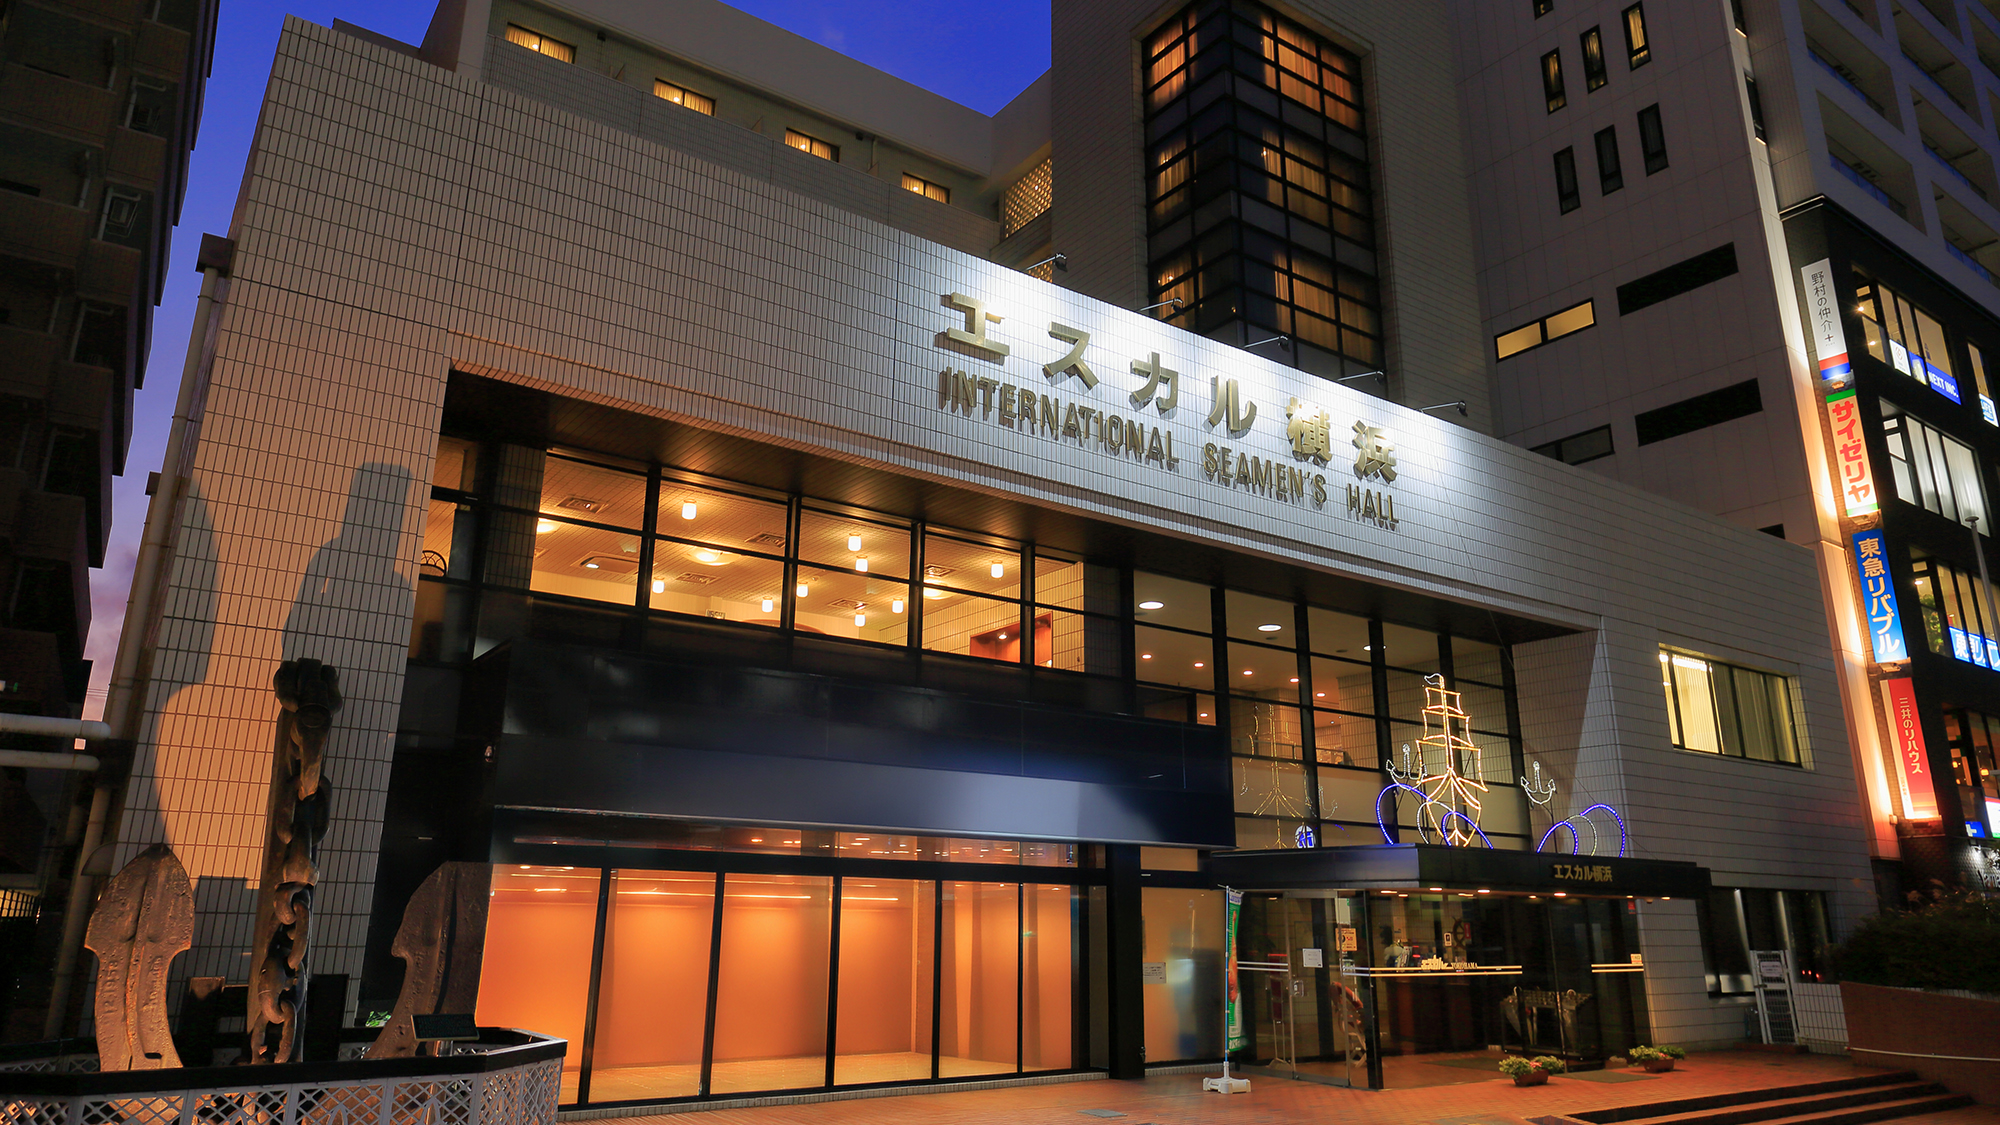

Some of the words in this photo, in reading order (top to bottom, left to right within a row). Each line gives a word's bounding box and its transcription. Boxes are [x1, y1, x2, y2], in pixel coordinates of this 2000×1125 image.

[940, 366, 1179, 469] INTERNATIONAL
[1203, 441, 1328, 507] SEAMEN'S
[1347, 483, 1400, 528] HALL
[1831, 399, 1871, 504] サイゼリヤ
[1857, 537, 1901, 656] 東急リバブル
[1899, 697, 1923, 774] 三井のリハウス
[1553, 864, 1613, 882] エスカル横浜
